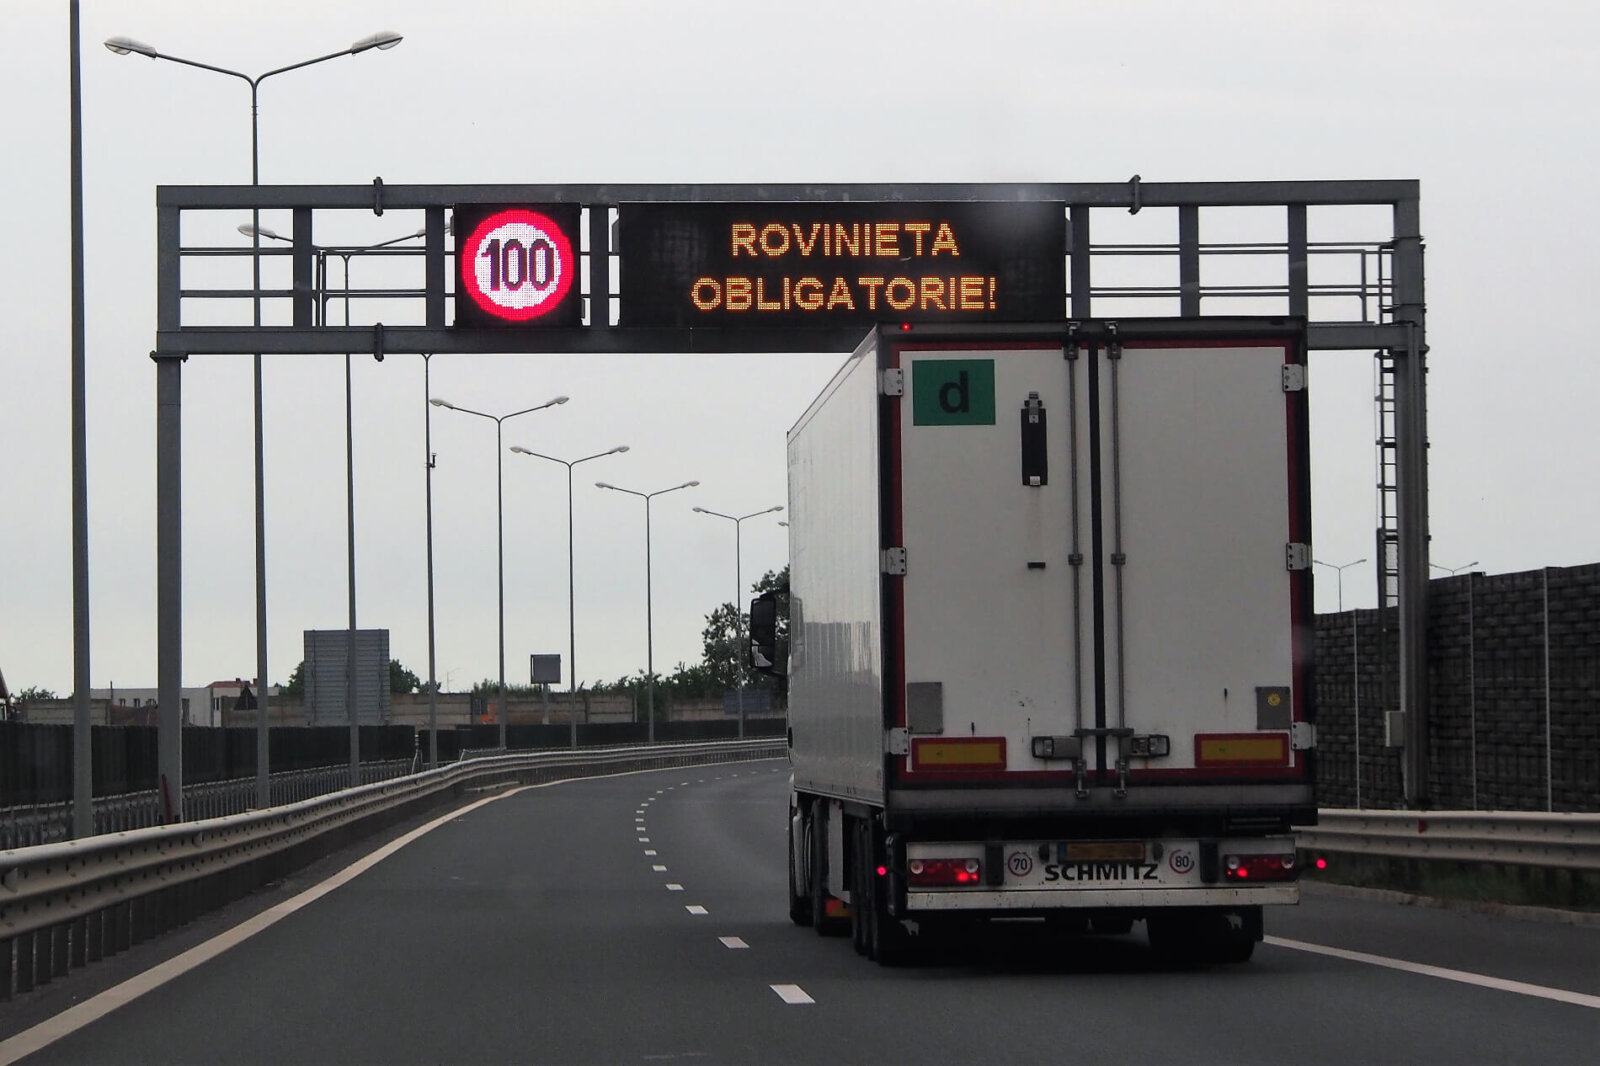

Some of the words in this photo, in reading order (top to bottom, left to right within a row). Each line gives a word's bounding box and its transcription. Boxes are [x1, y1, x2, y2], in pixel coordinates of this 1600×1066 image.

[731, 223, 959, 256] ROVINIETA
[481, 239, 554, 291] 100
[691, 277, 996, 310] OBLIGATORIE!
[939, 370, 968, 413] d
[1013, 858, 1027, 870] 70
[1045, 863, 1158, 880] SCHMITZ
[1175, 855, 1189, 868] 80
